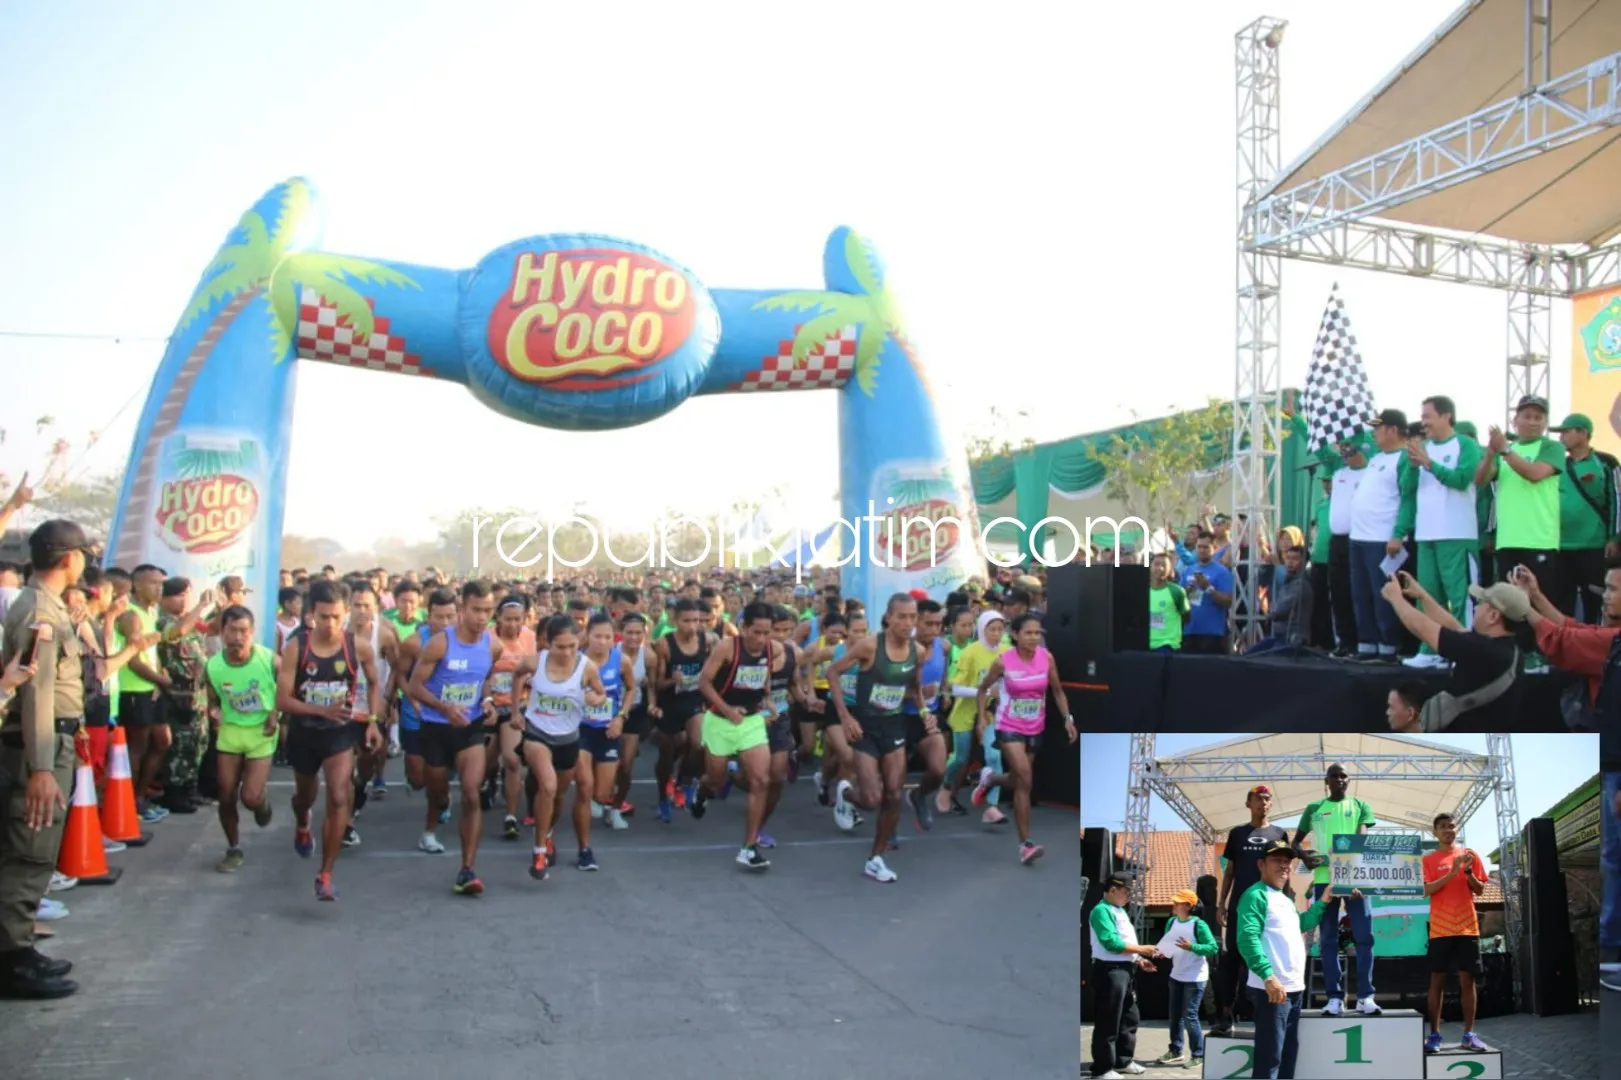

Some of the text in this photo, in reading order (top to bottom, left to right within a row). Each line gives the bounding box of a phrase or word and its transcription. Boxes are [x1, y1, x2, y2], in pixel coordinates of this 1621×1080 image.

[511, 251, 687, 310] Hydro
[504, 301, 664, 379] Coco
[161, 479, 253, 513] Hydro
[158, 507, 244, 551] Coco
[1332, 1024, 1373, 1064] 1
